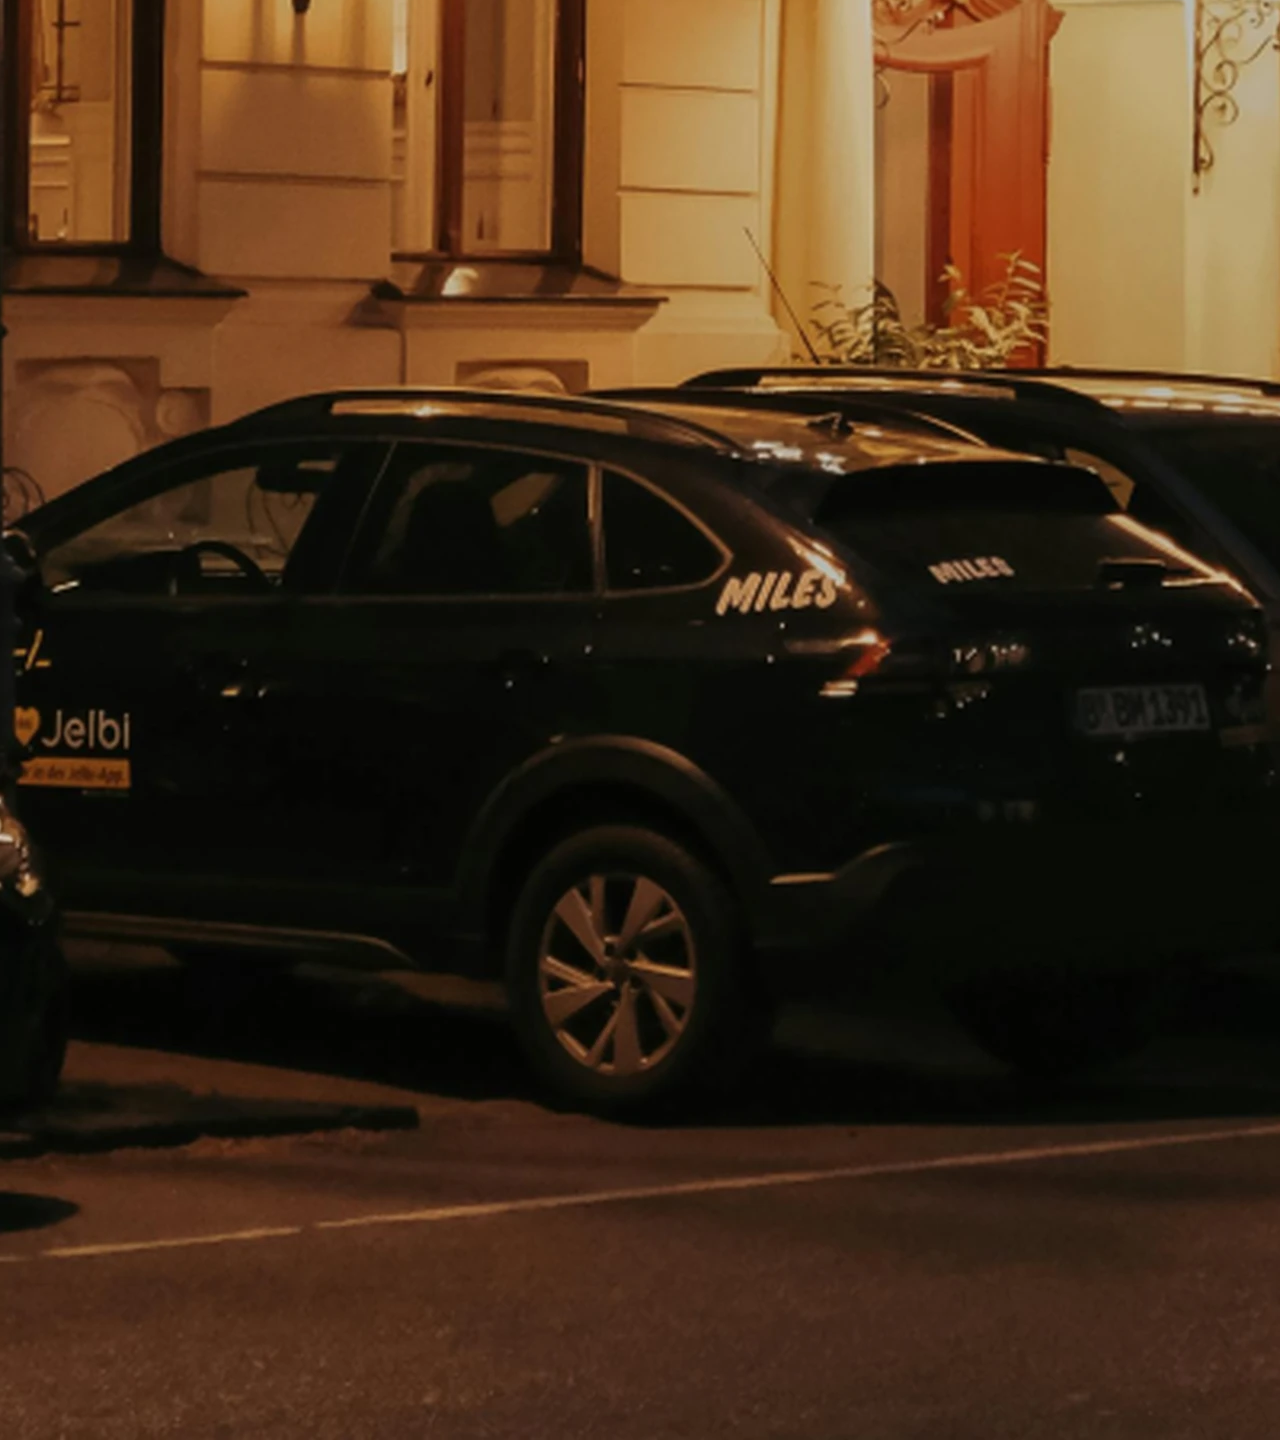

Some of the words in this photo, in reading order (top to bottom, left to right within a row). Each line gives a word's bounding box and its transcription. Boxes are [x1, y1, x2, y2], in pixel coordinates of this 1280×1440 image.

[927, 556, 1016, 585] MILES
[715, 569, 838, 617] MILES
[41, 707, 131, 751] Jelbi
